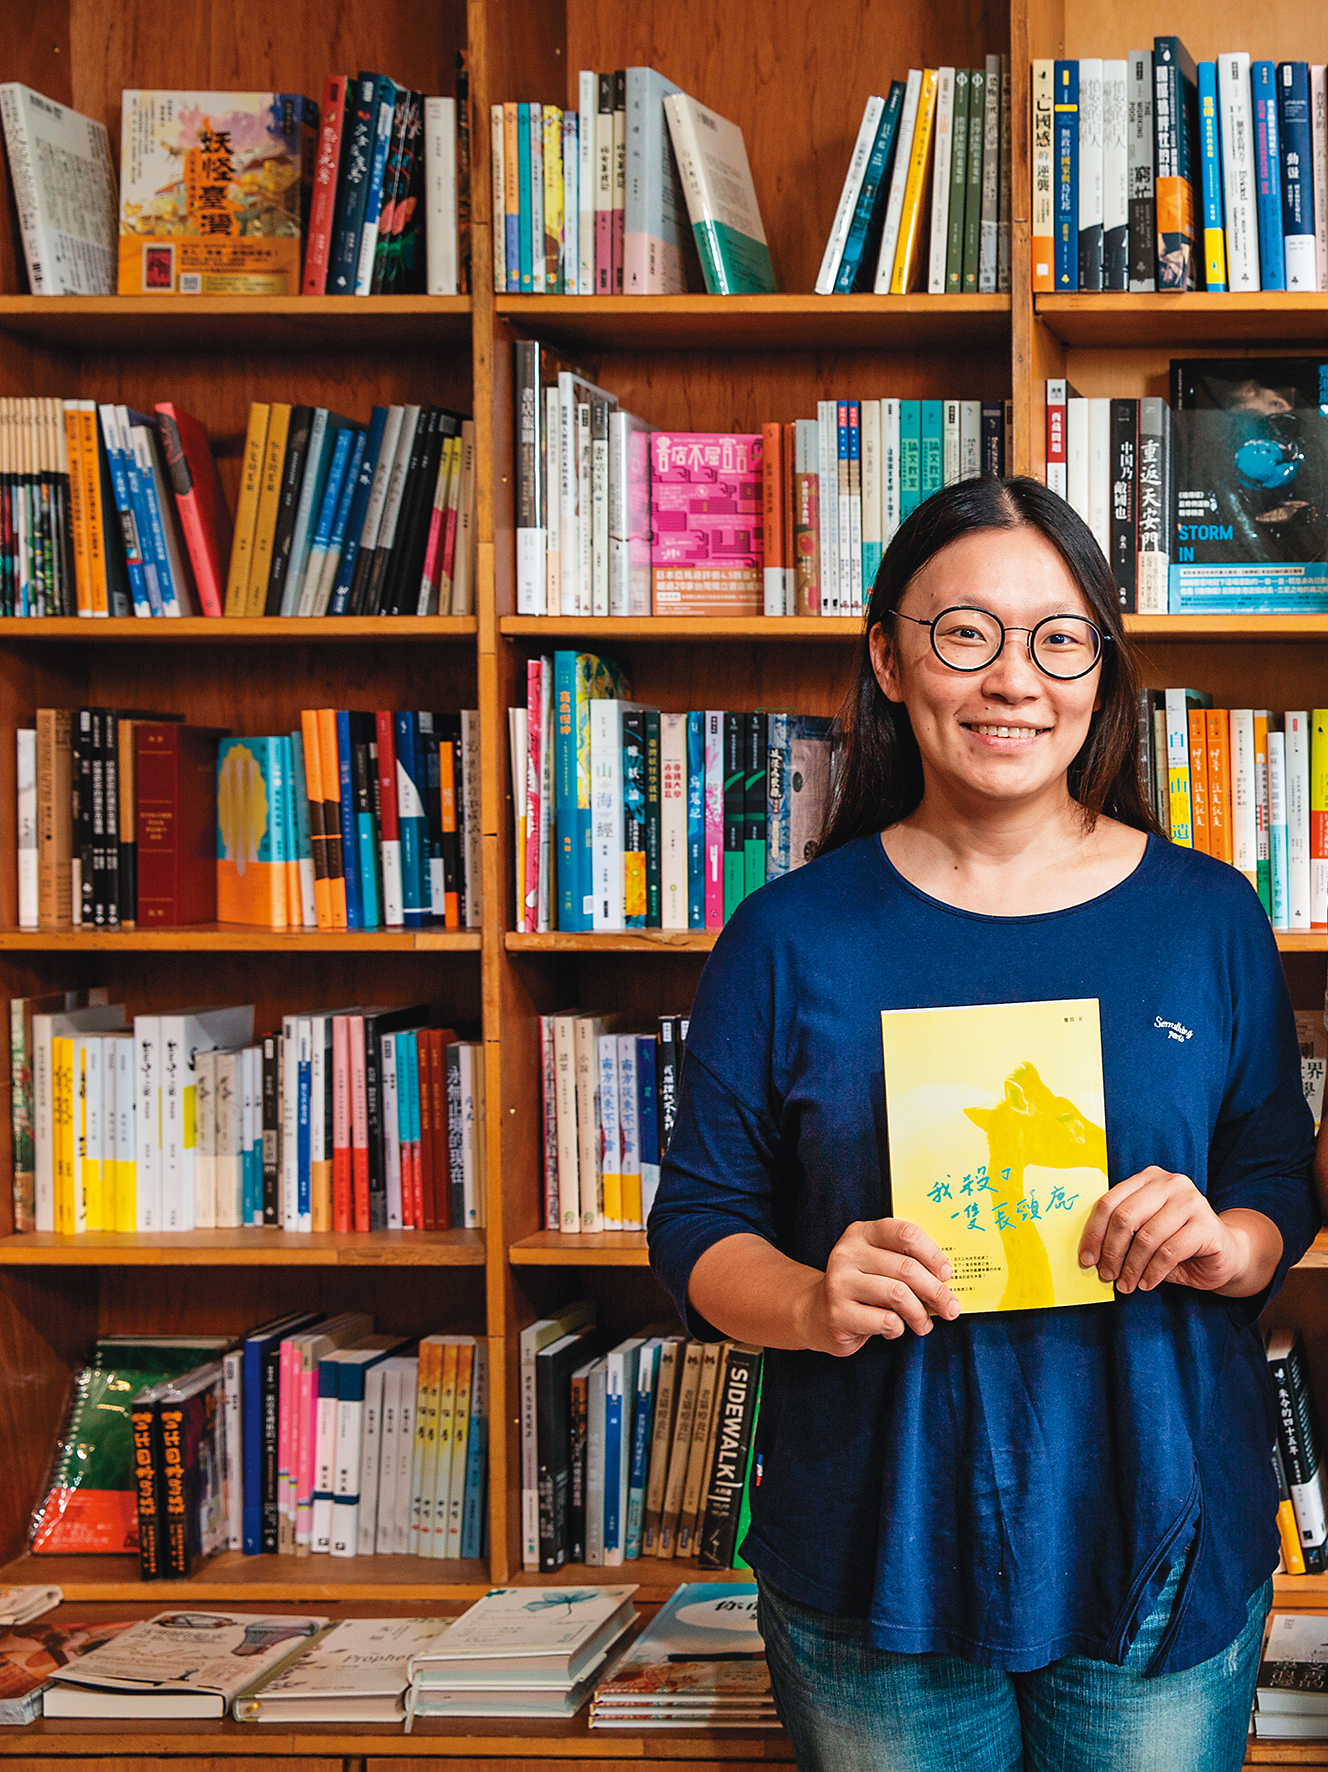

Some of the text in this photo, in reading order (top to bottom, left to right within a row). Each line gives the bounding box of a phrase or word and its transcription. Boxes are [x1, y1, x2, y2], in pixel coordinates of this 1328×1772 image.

[199, 130, 235, 236] 妖怪臺灣
[1139, 439, 1162, 552] 重返天安門
[1178, 525, 1234, 541] STORM
[1178, 546, 1195, 562] IN
[927, 1165, 1012, 1202] 我殺了
[950, 1185, 1080, 1232] 一隻長頸鹿
[715, 1367, 749, 1481] SIDEWALK
[343, 1652, 416, 1665] Prophet
